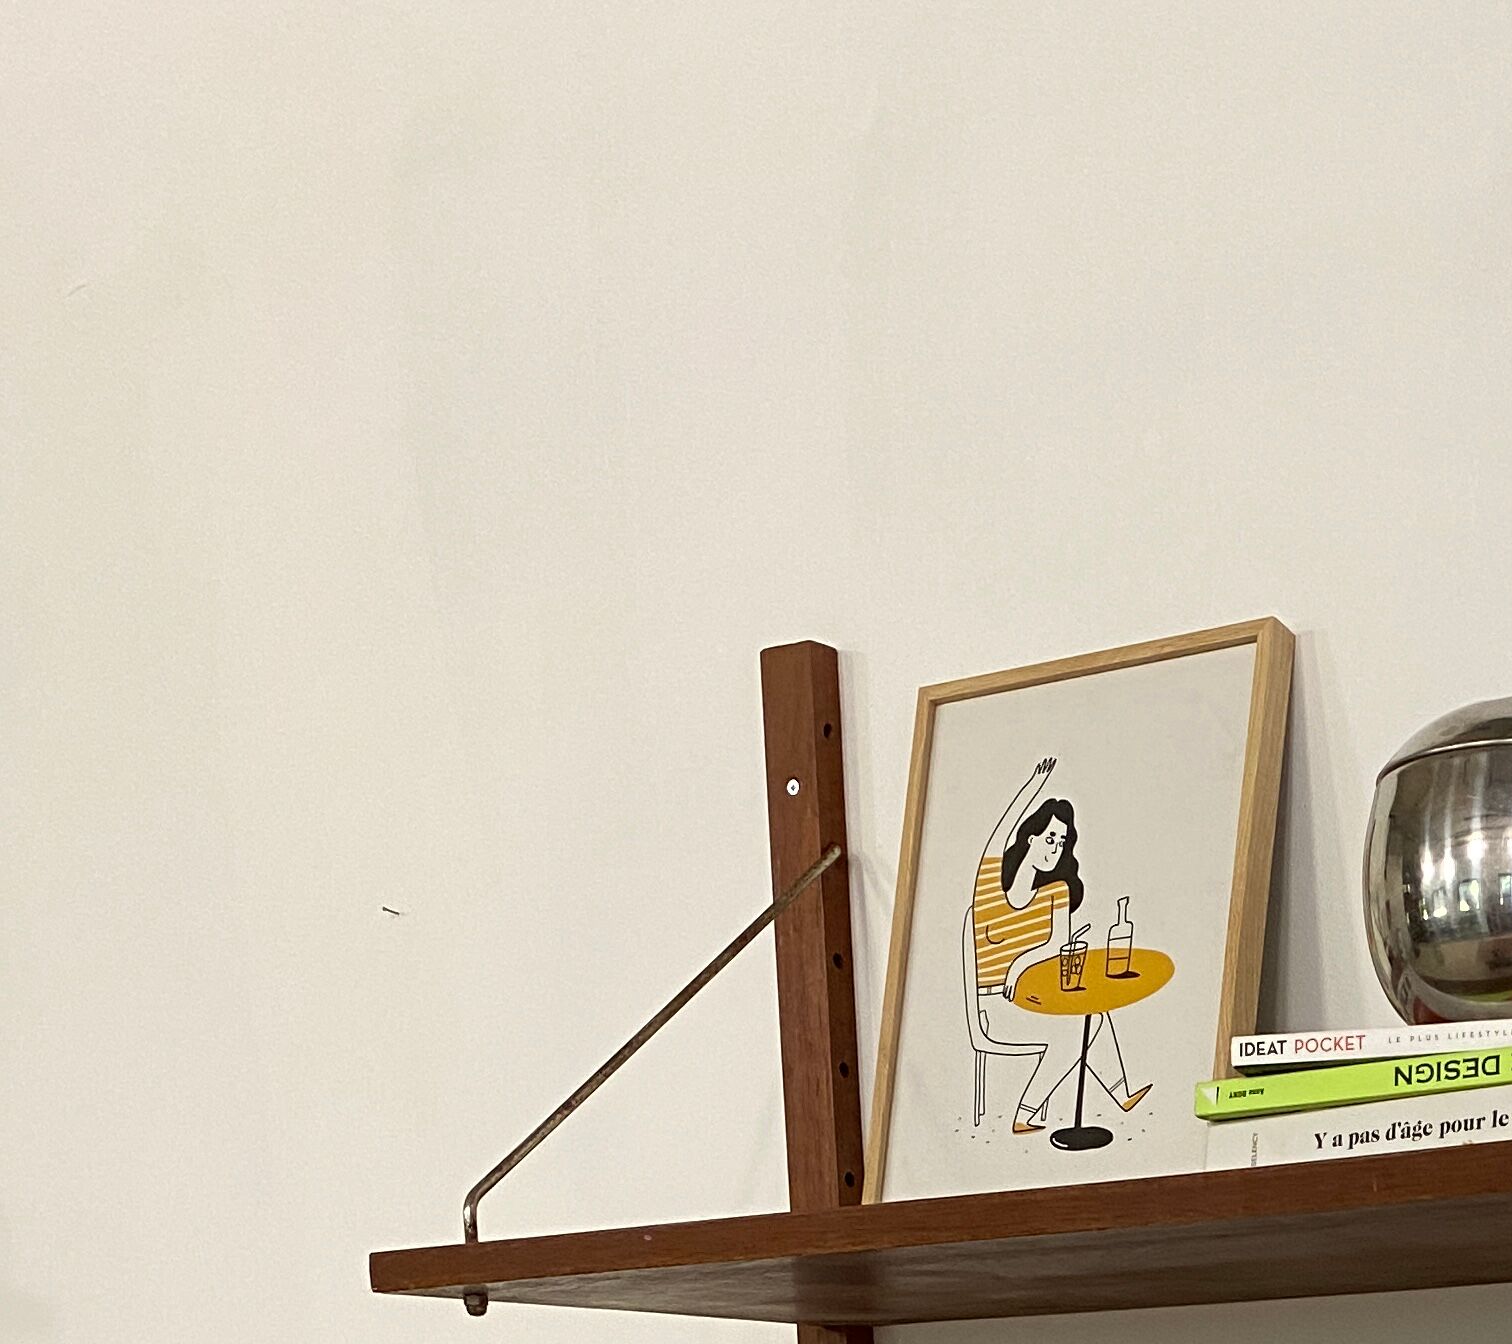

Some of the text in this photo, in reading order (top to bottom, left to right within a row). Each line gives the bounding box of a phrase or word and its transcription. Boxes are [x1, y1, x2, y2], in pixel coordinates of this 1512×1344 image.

[1239, 1034, 1366, 1057] IDEAT POCKET
[1388, 1036, 1401, 1044] LE
[1409, 1034, 1440, 1043] PLUS
[1393, 1054, 1501, 1087] DESIGN
[1314, 1132, 1327, 1150] Y
[1331, 1135, 1343, 1148] a
[1348, 1129, 1380, 1151] pas
[1385, 1120, 1433, 1142] d'âge
[1439, 1115, 1487, 1138] pour
[1492, 1109, 1509, 1128] le
